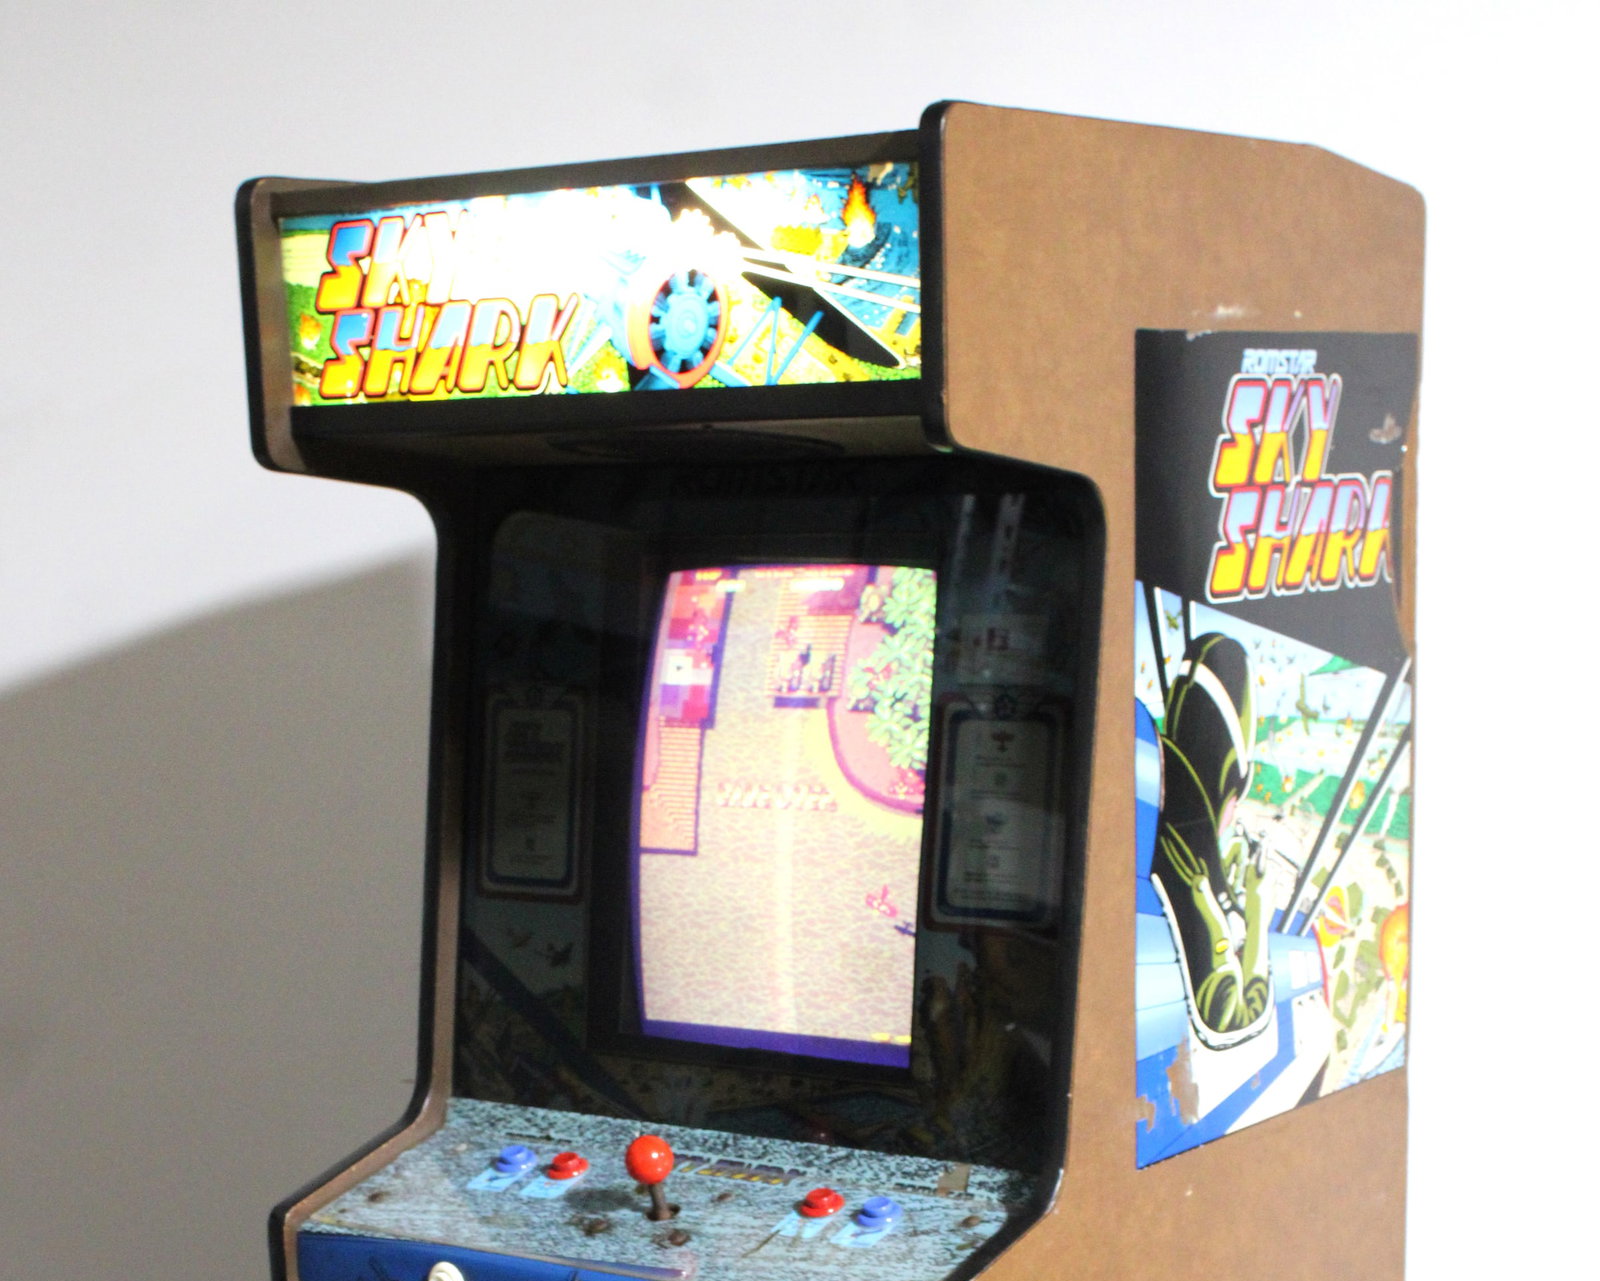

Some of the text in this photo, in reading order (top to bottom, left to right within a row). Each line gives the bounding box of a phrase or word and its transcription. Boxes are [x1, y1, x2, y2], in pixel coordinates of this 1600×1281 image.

[316, 208, 470, 313] SKY
[319, 291, 581, 399] SHARK
[1208, 373, 1343, 498] SKY
